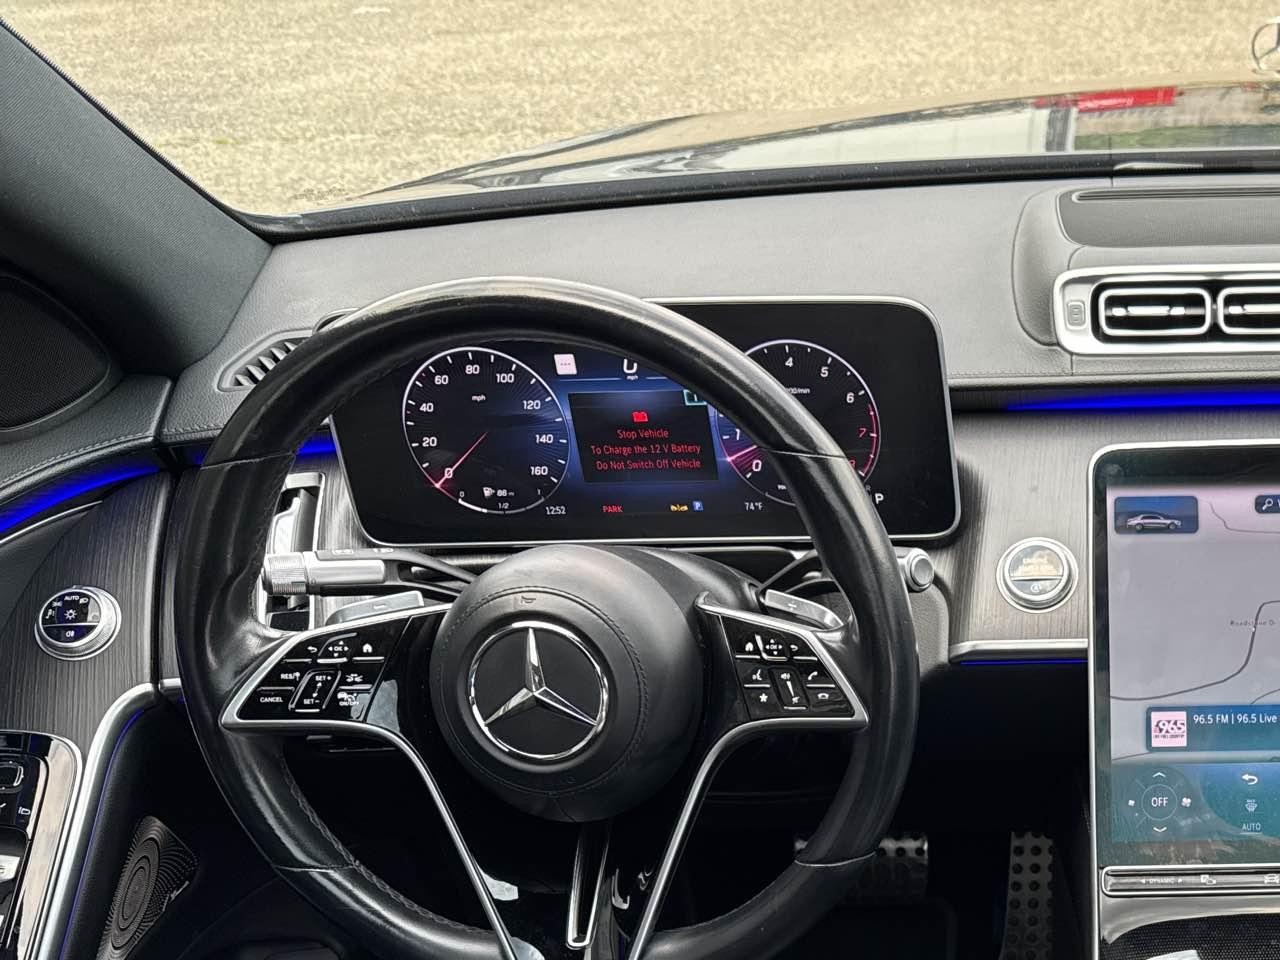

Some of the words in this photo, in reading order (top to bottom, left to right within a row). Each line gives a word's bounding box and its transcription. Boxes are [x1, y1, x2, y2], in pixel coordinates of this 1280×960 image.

[785, 356, 794, 367] 4
[465, 364, 480, 374] 80
[820, 366, 829, 378] 5
[434, 375, 449, 385] 60
[495, 373, 514, 383] 100
[846, 392, 855, 403] 6
[419, 403, 434, 412] 40
[522, 400, 541, 410] 120
[616, 429, 637, 440] Stop
[639, 429, 669, 438] Vehicle
[735, 429, 740, 440] 1
[858, 428, 866, 437] 7
[422, 437, 437, 447] 20
[535, 434, 554, 444] 140
[591, 445, 601, 454] To
[603, 445, 632, 456] Charge
[634, 445, 648, 454] the
[651, 445, 661, 454] 12
[663, 445, 669, 453] V
[671, 444, 700, 454] Battery
[596, 461, 608, 470] Do
[610, 461, 625, 470] Not
[627, 460, 654, 469] Switch
[656, 460, 669, 469] Off
[672, 460, 701, 468] Vehicle
[752, 460, 762, 472] 0
[445, 467, 453, 478] 0
[530, 466, 548, 476] 160
[875, 493, 884, 504] P
[1193, 714, 1213, 724] 96.5
[1216, 714, 1228, 724] FM
[1237, 713, 1257, 723] 96.5
[1260, 713, 1277, 723] Live
[1151, 797, 1168, 807] OFF
[1242, 823, 1261, 831] AUTO
